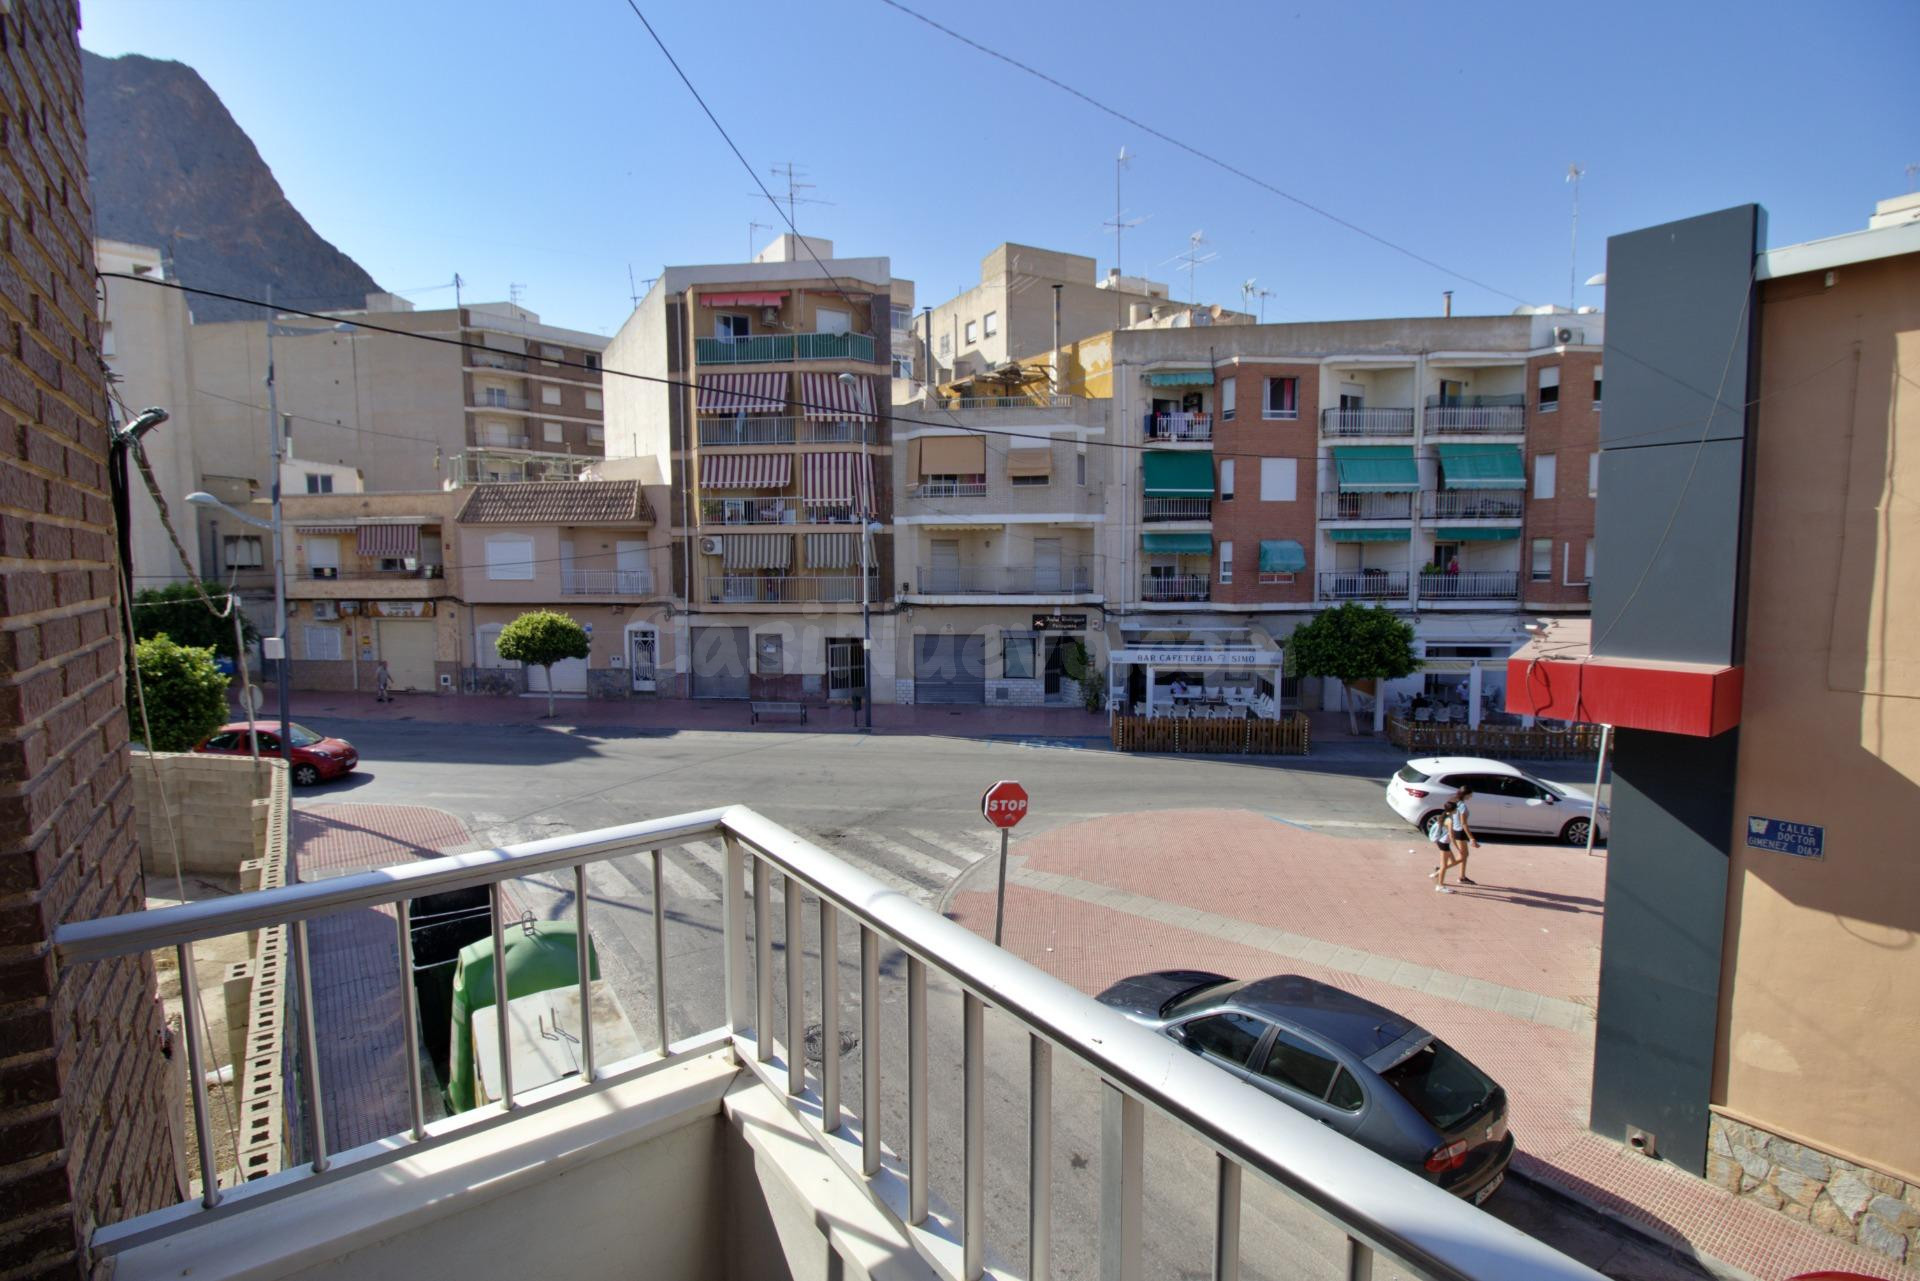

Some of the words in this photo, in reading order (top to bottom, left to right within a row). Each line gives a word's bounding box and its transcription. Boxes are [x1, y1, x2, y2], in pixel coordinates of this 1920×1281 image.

[1137, 654, 1156, 662] BAR
[1231, 655, 1256, 664] SIMO
[989, 799, 1027, 812] STOP
[1778, 822, 1815, 837] CALLE
[1777, 832, 1817, 846] DOCTOR
[1748, 836, 1789, 851] GIMENEZ
[1796, 844, 1820, 857] DIAZ
